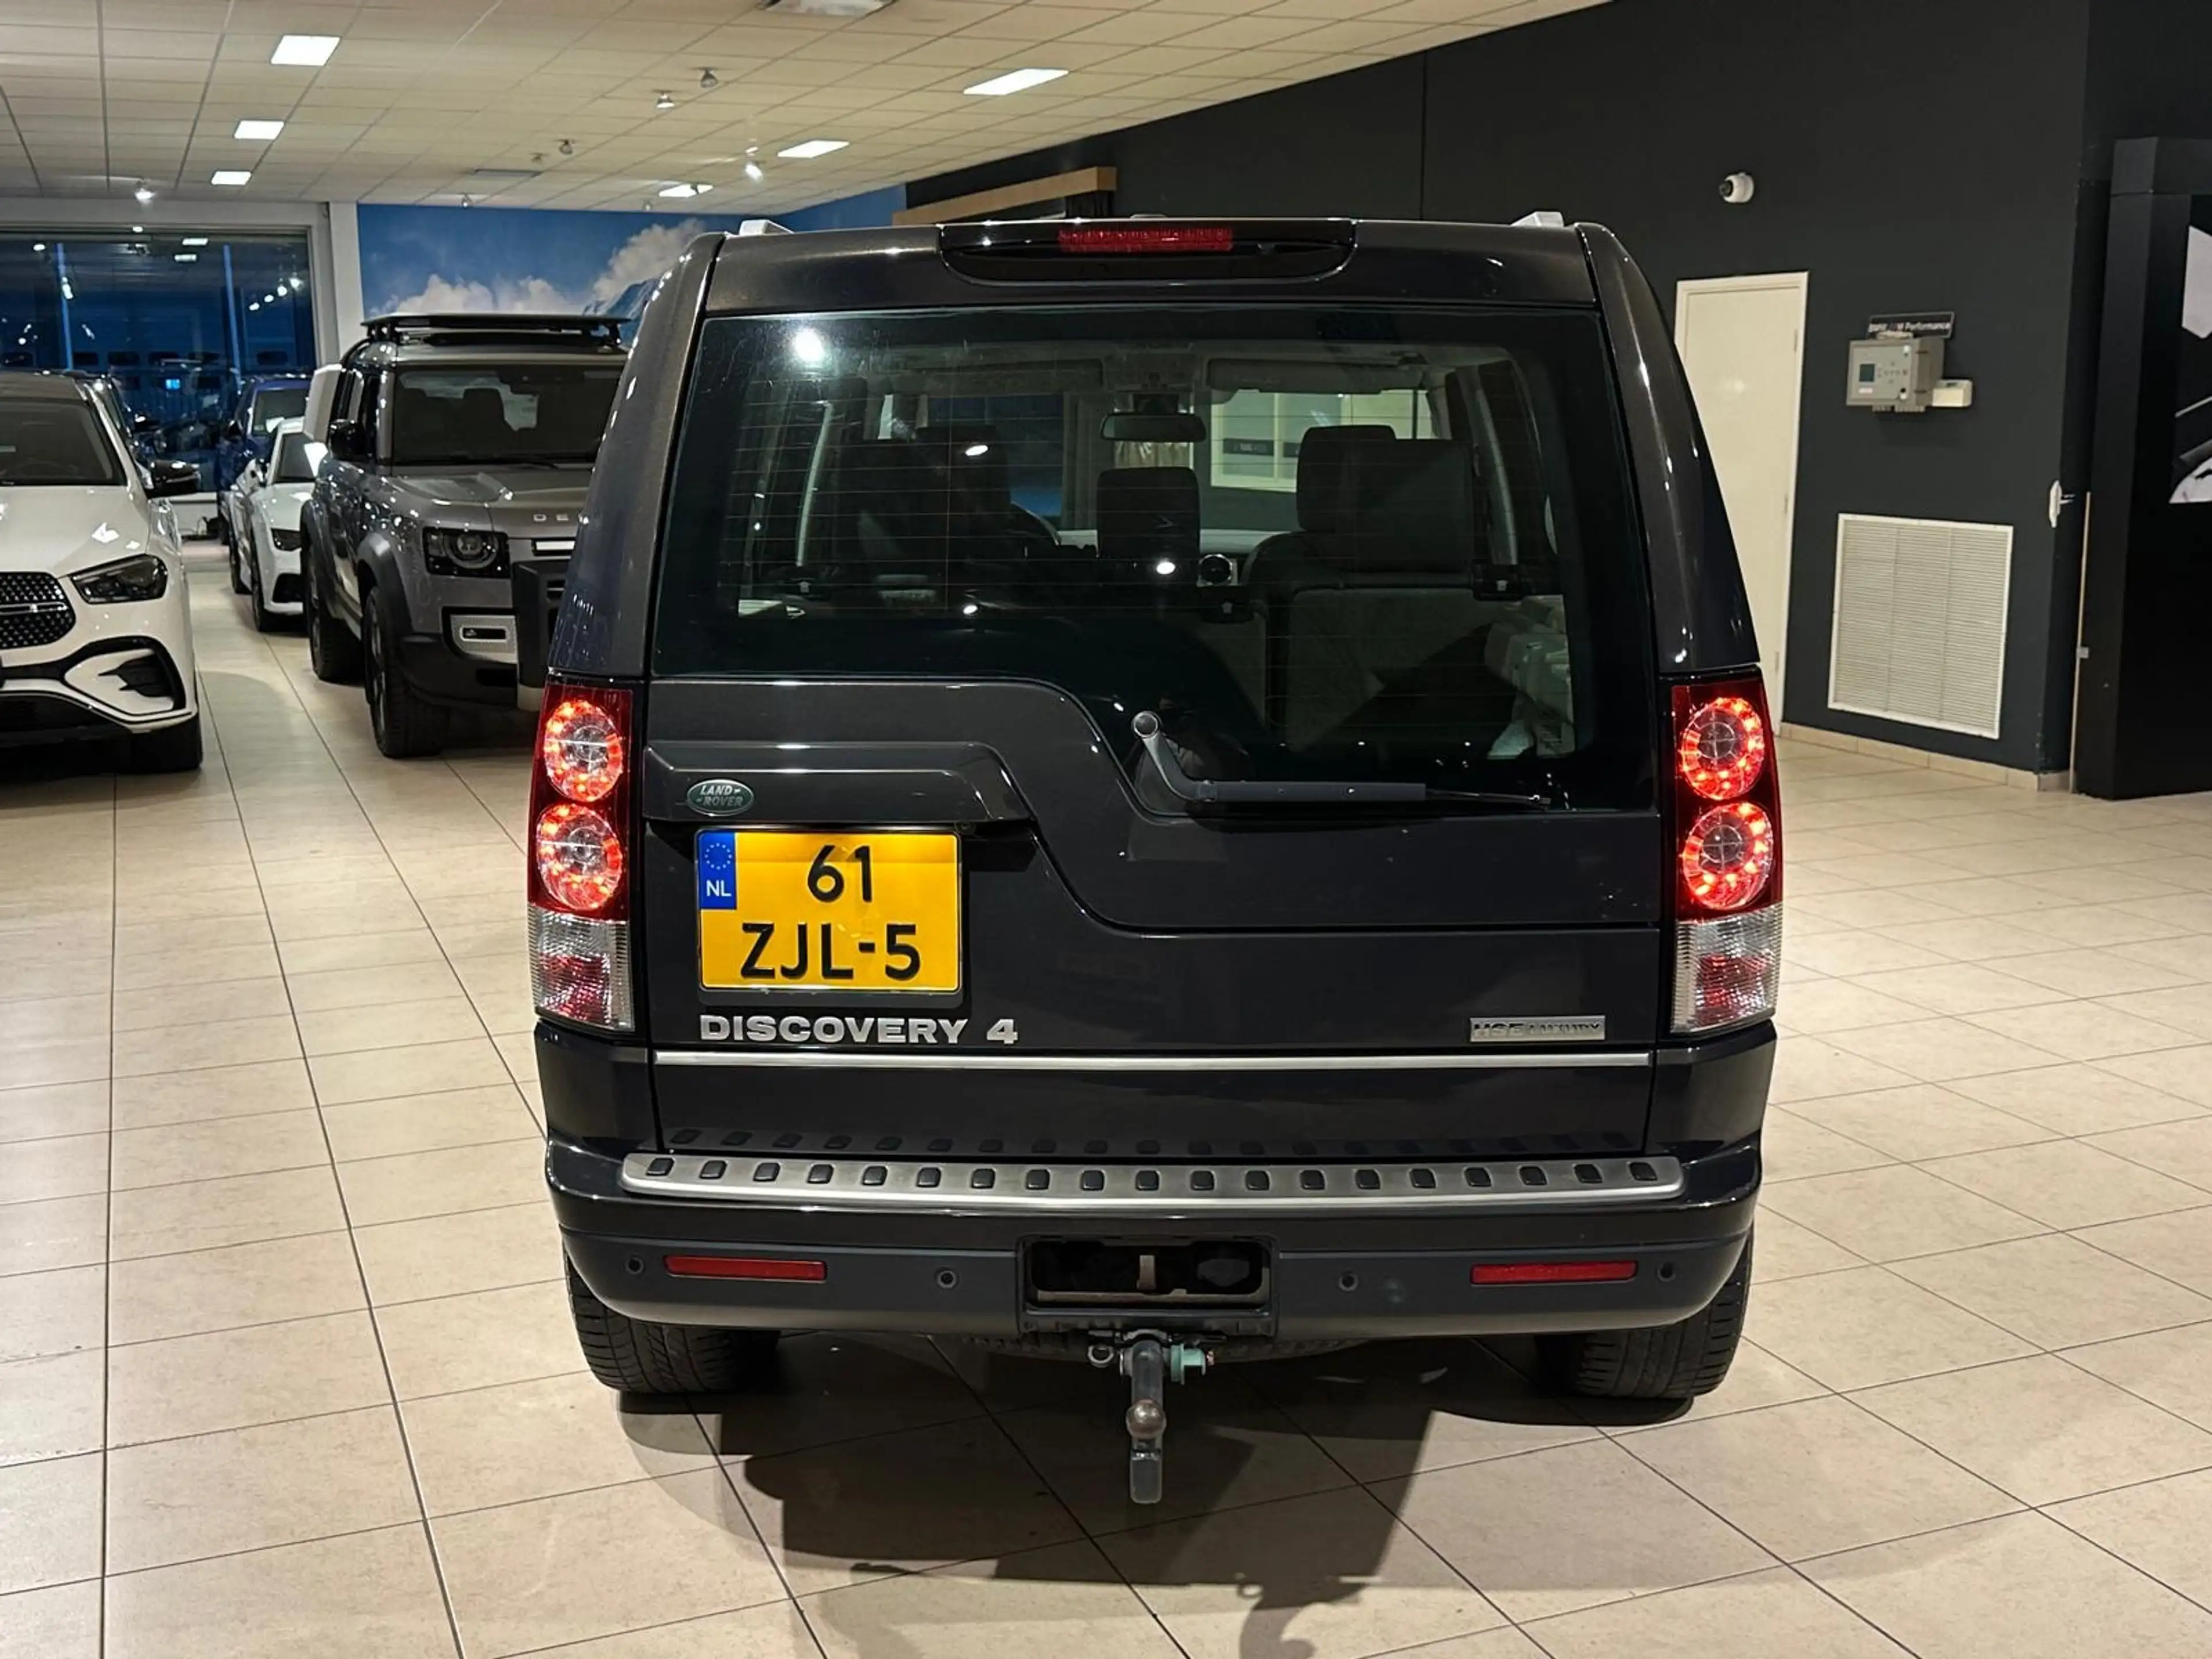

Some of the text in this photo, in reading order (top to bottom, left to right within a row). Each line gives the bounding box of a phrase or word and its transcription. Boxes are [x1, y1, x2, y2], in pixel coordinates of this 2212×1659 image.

[706, 879, 732, 897] NL
[807, 845, 872, 903] 61
[740, 922, 921, 981] ZJL-5
[700, 1015, 1018, 1044] DISCOVERY 4
